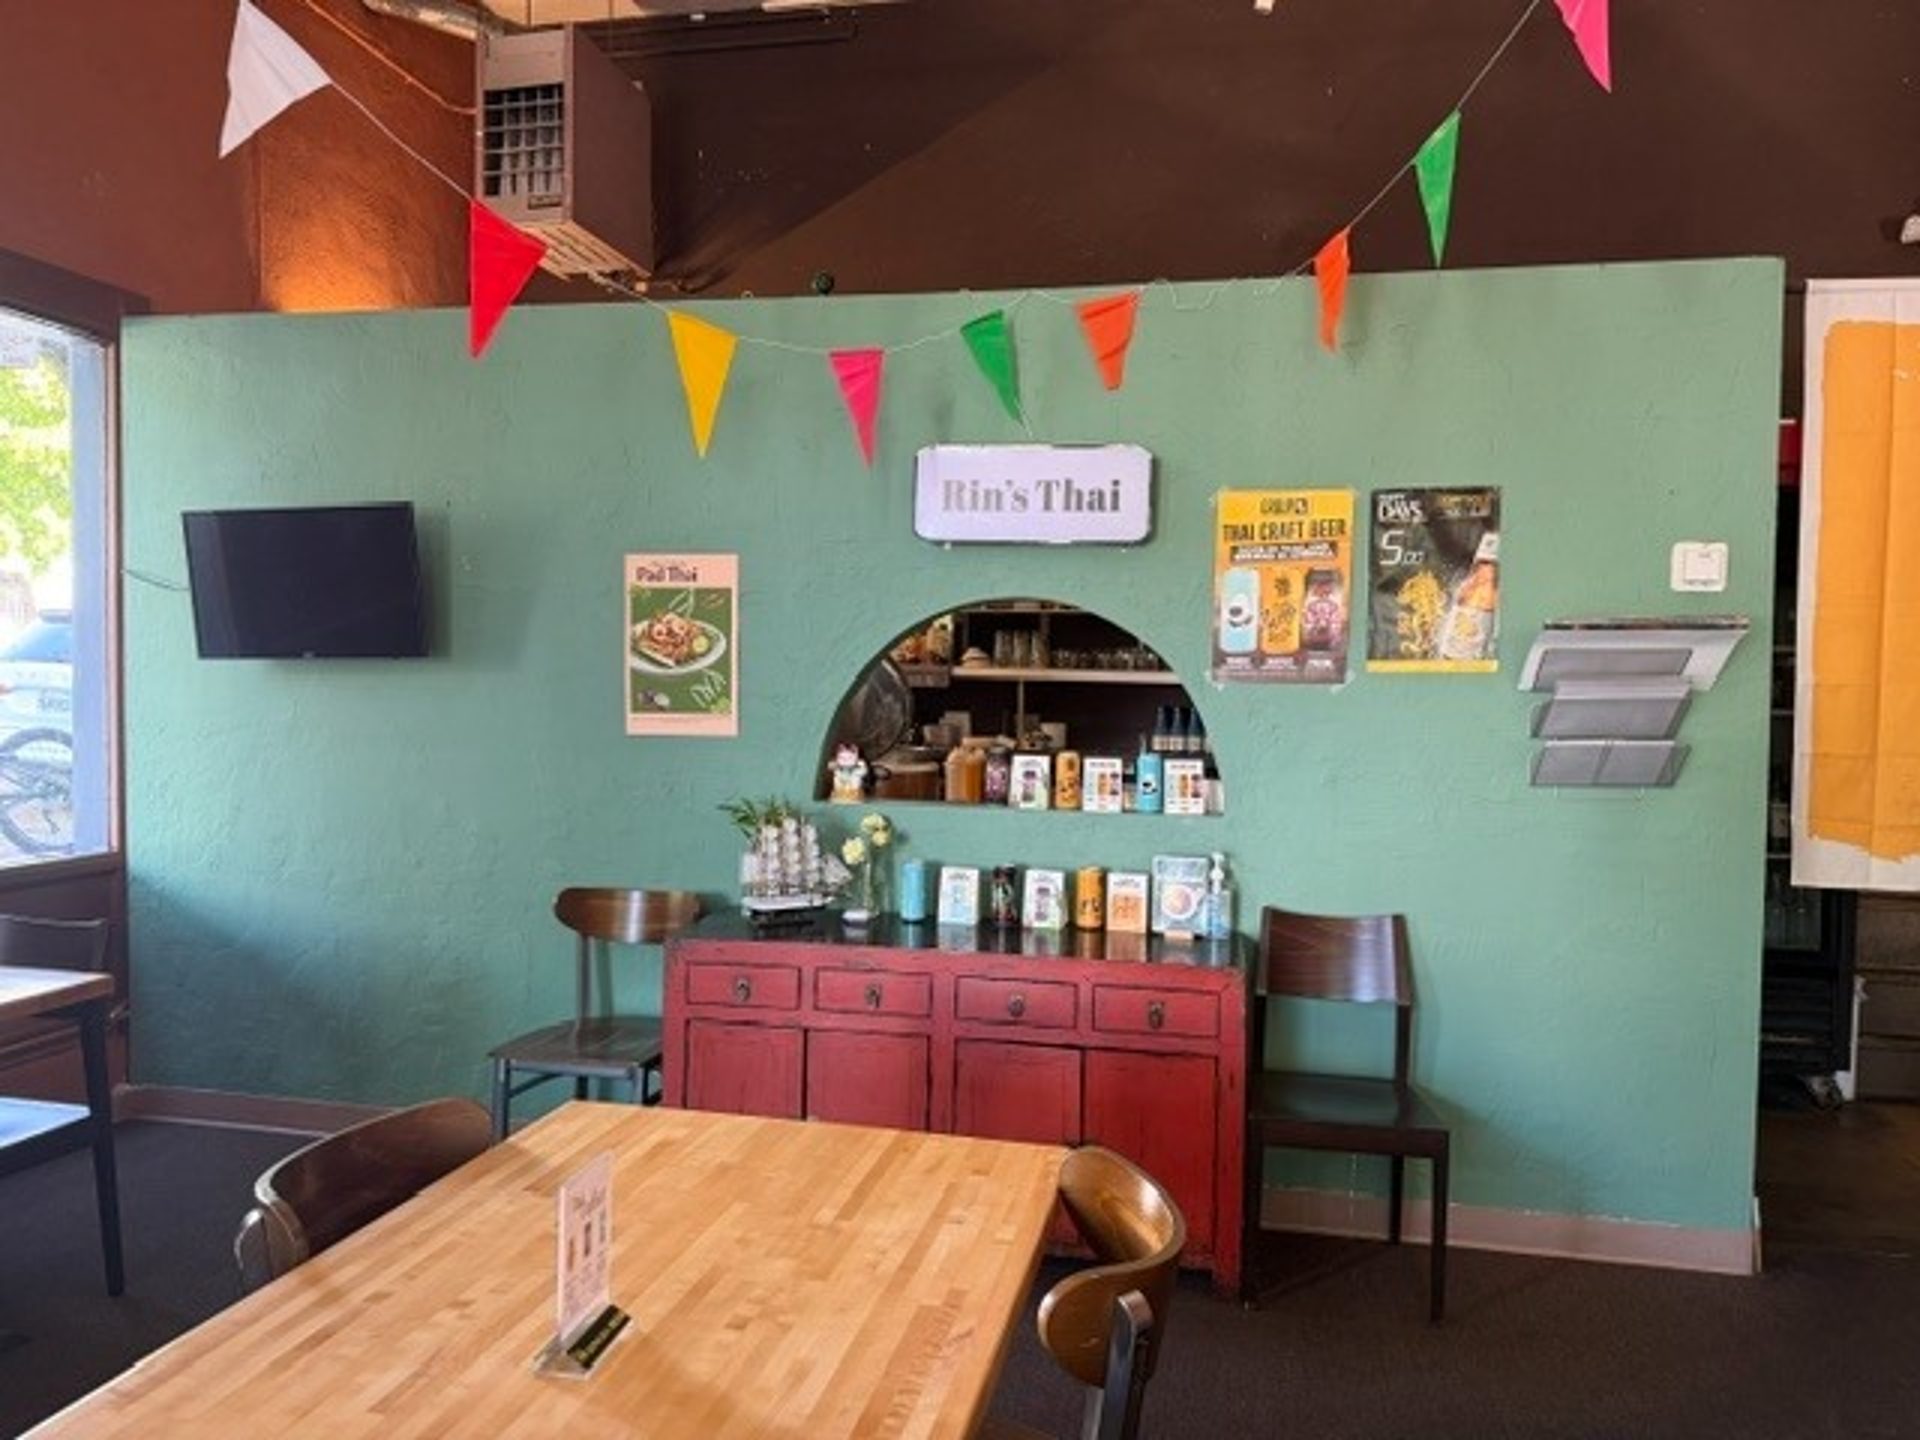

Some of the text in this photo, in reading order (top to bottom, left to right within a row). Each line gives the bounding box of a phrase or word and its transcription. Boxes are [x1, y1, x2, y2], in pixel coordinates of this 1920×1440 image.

[942, 479, 1121, 512] Rin's Thai
[1223, 519, 1346, 541] THAI CRAFT BEER
